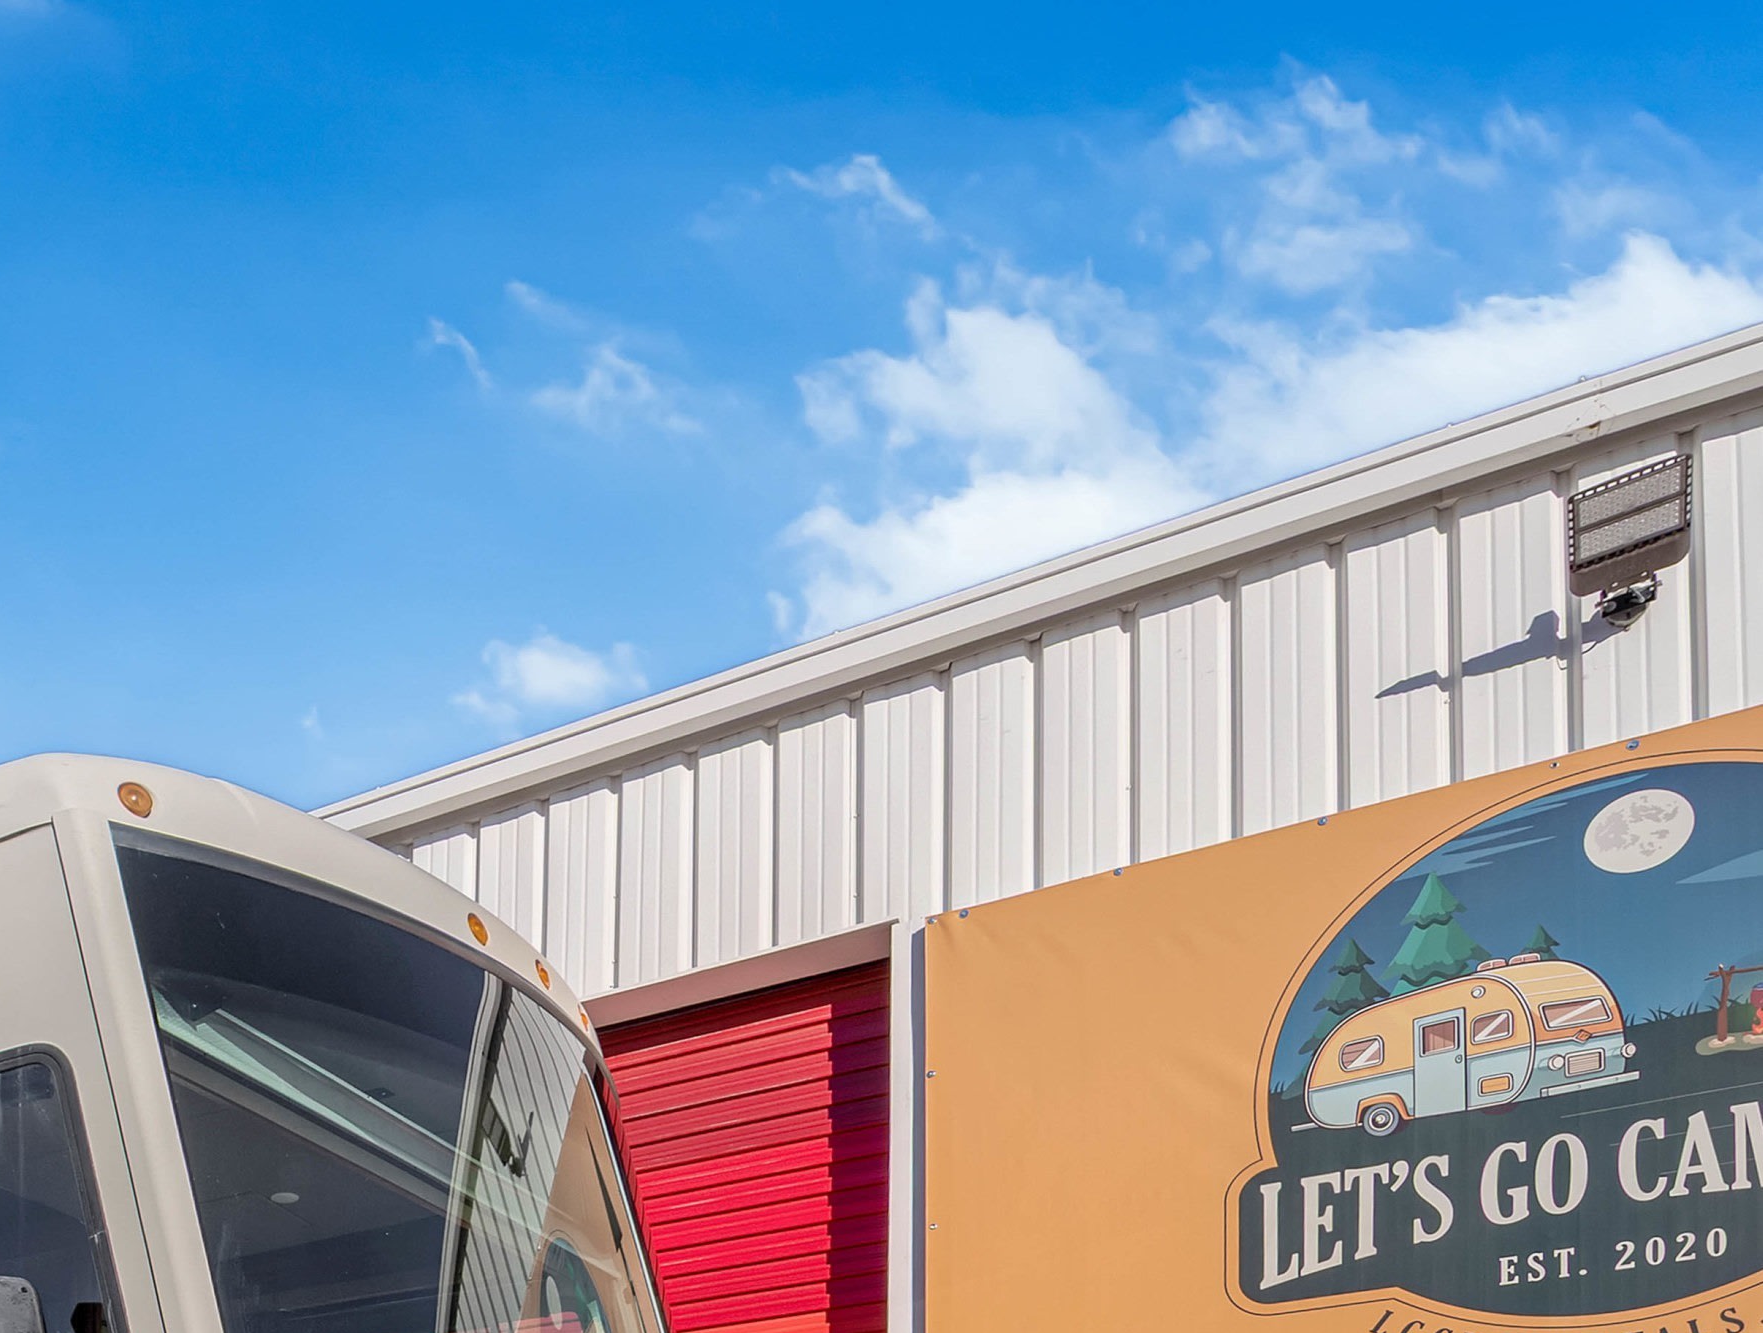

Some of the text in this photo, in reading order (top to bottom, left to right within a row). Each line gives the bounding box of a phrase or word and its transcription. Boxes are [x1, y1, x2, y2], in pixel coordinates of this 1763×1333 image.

[1259, 1154, 1455, 1291] LET'S
[1480, 1132, 1589, 1226] GO
[1498, 1227, 1728, 1286] EST. 2020
